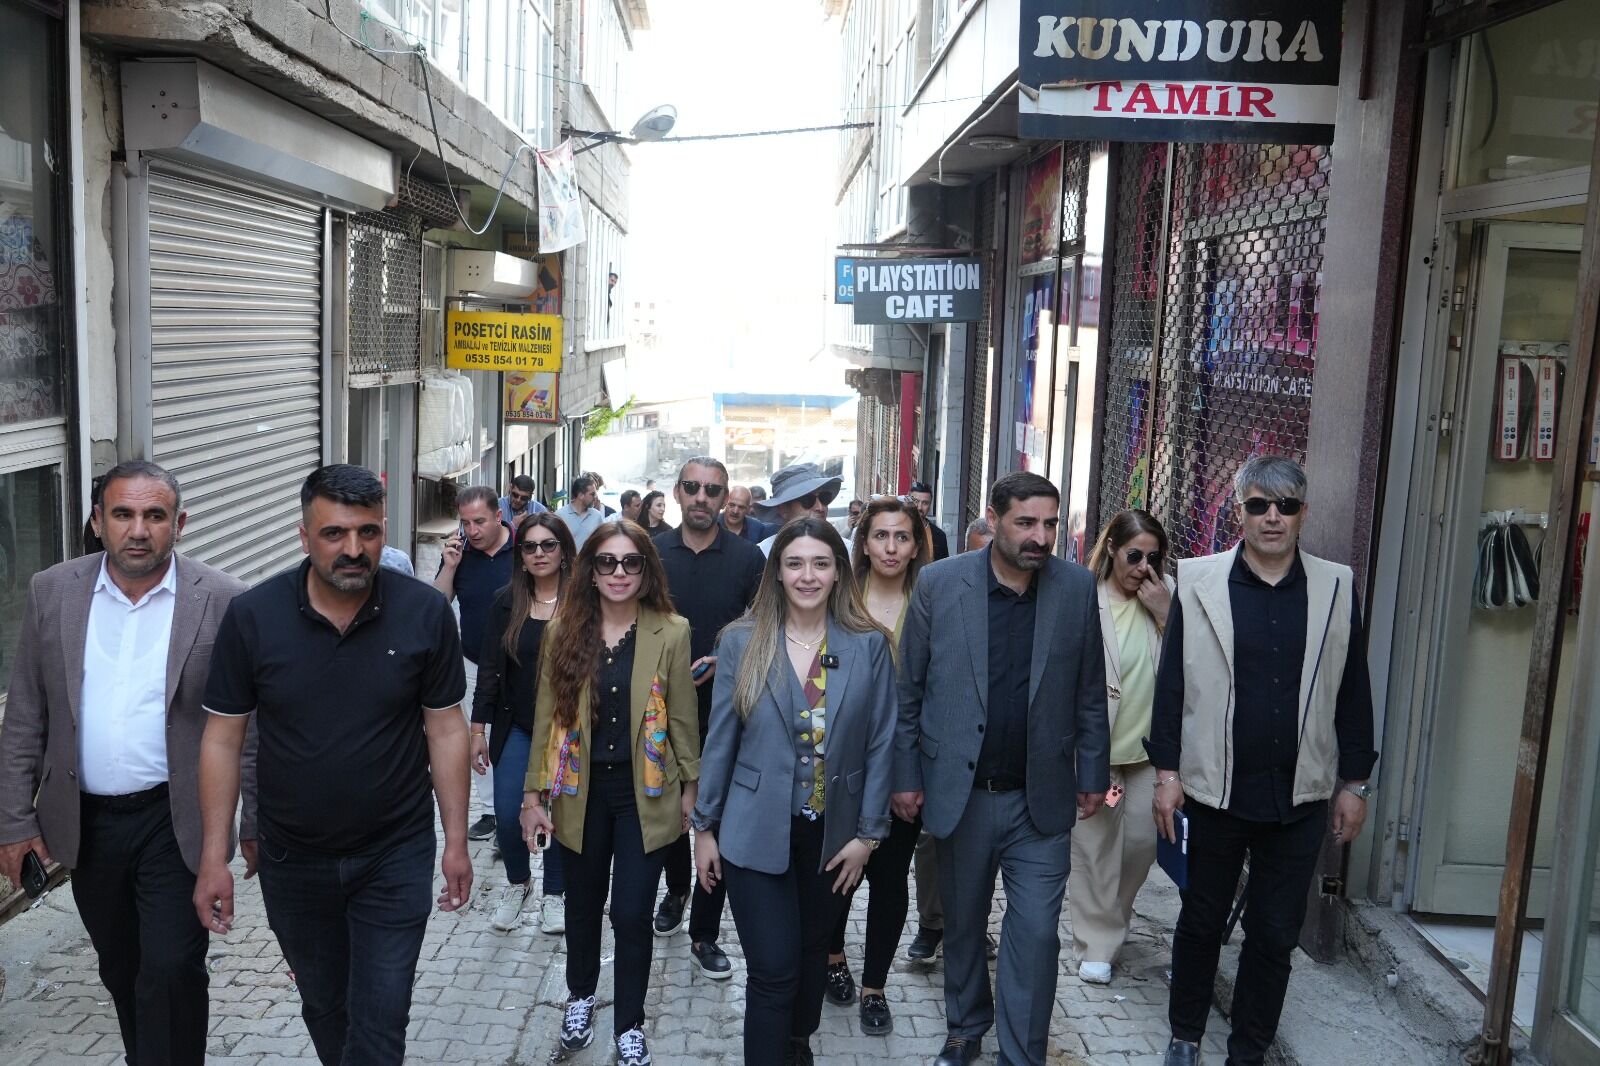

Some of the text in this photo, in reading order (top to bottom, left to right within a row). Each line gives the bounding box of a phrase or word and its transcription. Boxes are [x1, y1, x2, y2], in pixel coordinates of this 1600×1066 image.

[1033, 15, 1324, 63] KUNDURA
[857, 259, 980, 292] PLAYSTATİON
[885, 294, 954, 319] CAFE
[454, 321, 552, 341] POŞETCİ RASİM
[453, 339, 552, 355] AMBALAJ ve TEMİZLİK MALZEMESİ
[465, 353, 544, 367] 0535 854 01 78
